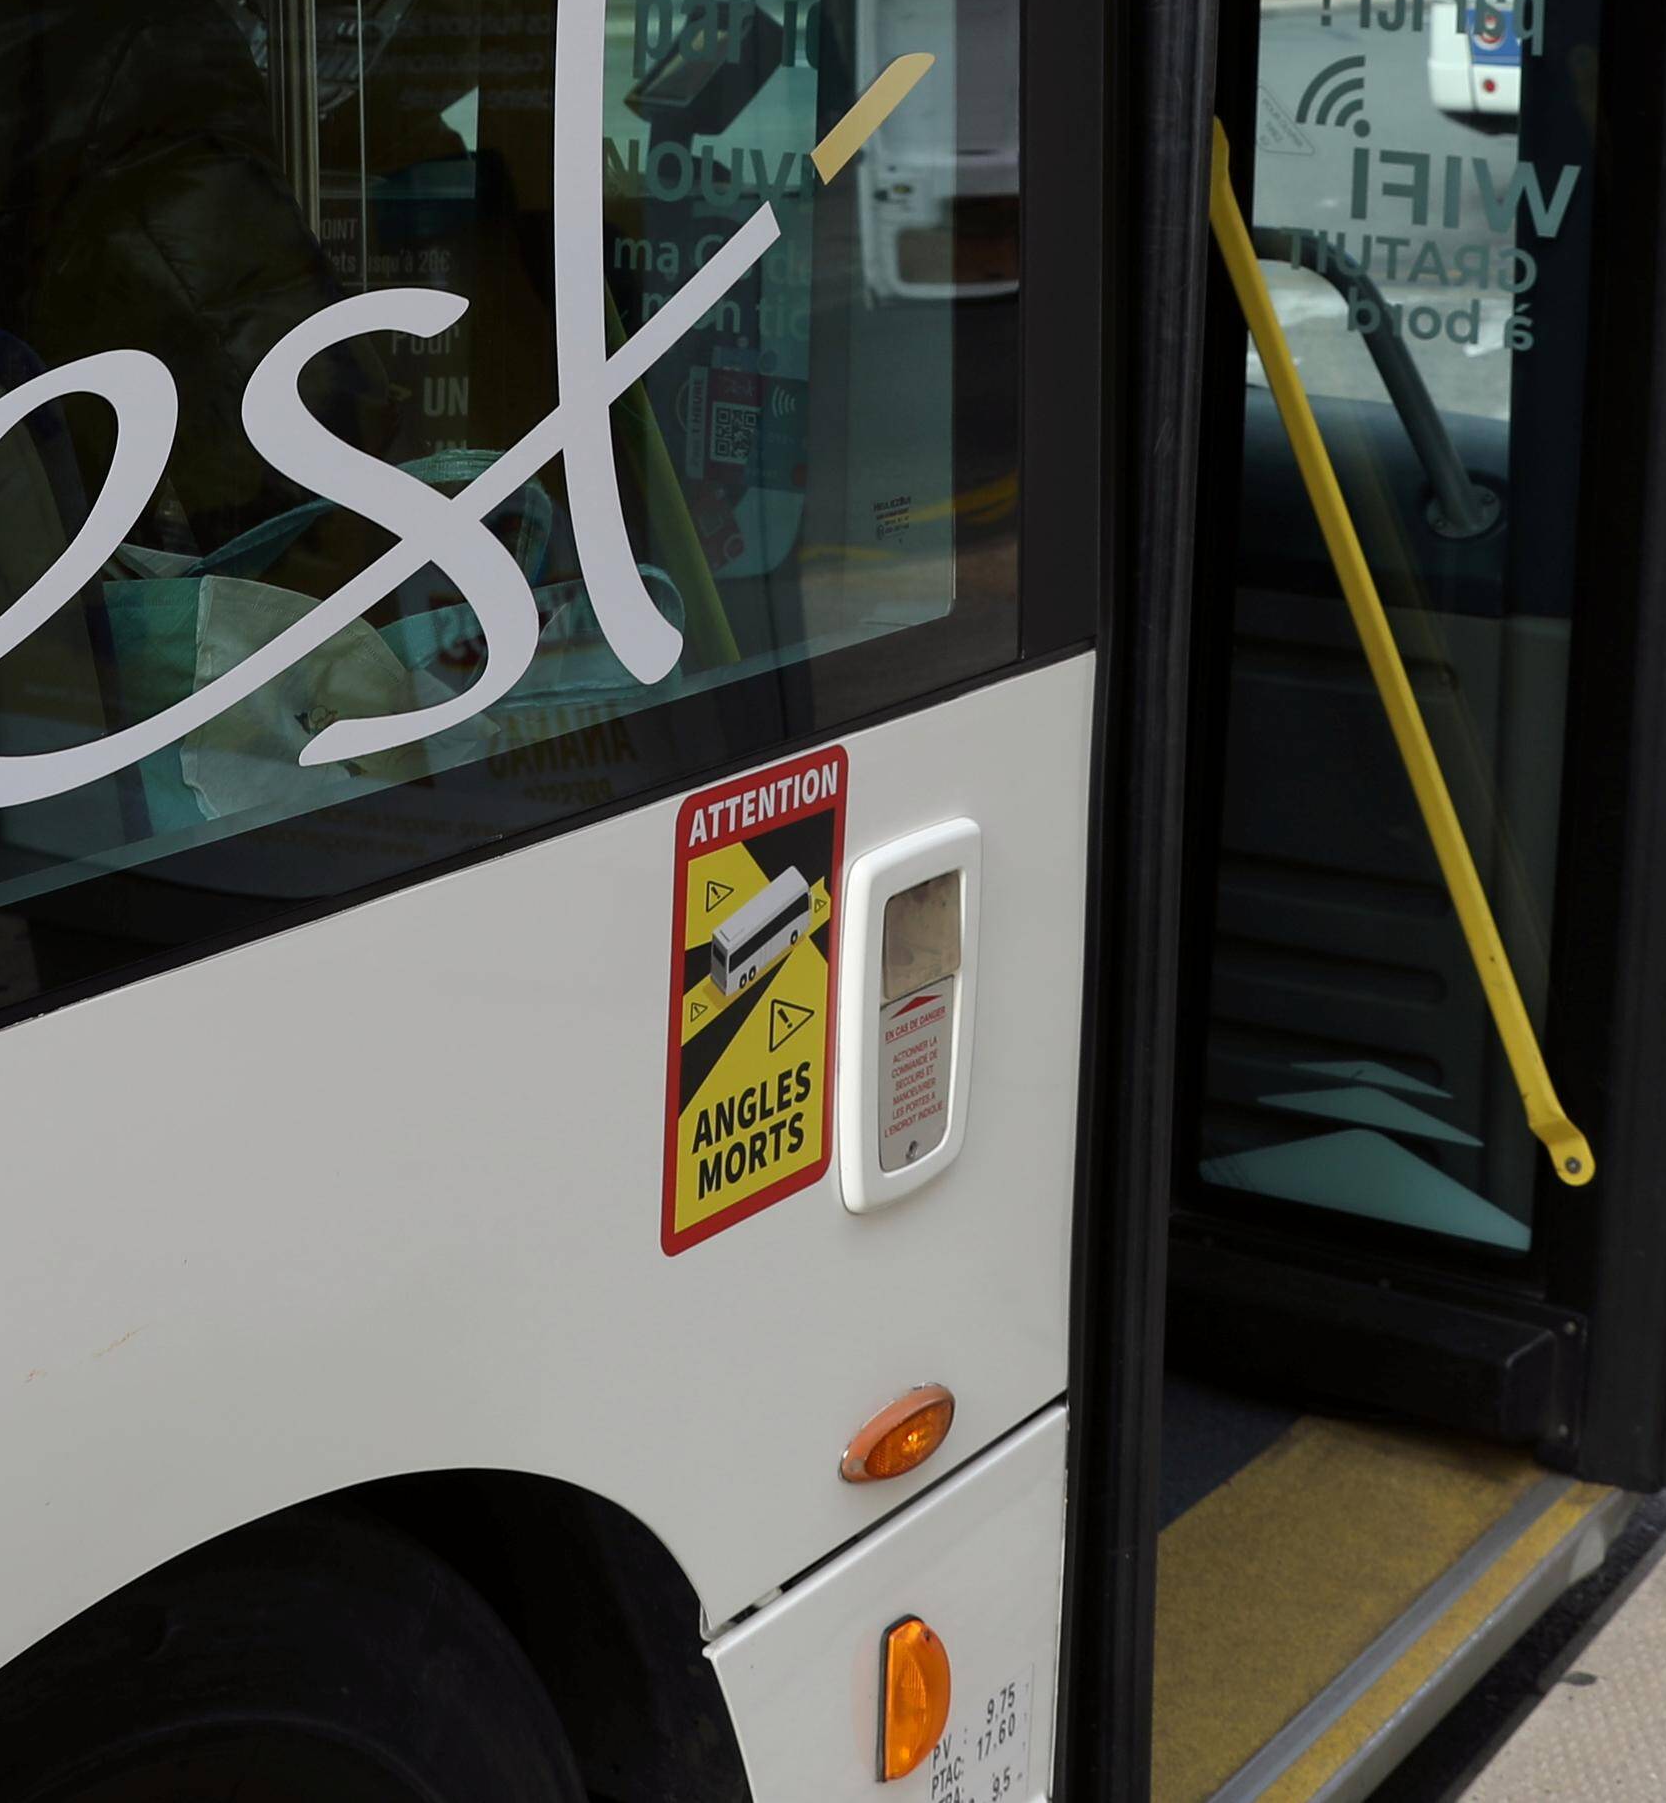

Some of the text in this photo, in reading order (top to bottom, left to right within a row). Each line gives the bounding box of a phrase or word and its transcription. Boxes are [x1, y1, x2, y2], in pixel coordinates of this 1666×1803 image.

[687, 760, 840, 849] ATTENTION
[884, 1005, 946, 1043] EN CAS DE DANGER
[891, 1048, 938, 1079] COMMANDE DE
[892, 1039, 929, 1064] ACTIONNER
[895, 1064, 934, 1092] SECOURS ET
[691, 1060, 813, 1155] ANGLES
[892, 1105, 905, 1121] LES
[905, 1095, 929, 1114] PORTES
[697, 1111, 806, 1201] MORTS
[986, 1682, 1015, 1725] 9.75
[976, 1712, 1016, 1762] 17.60
